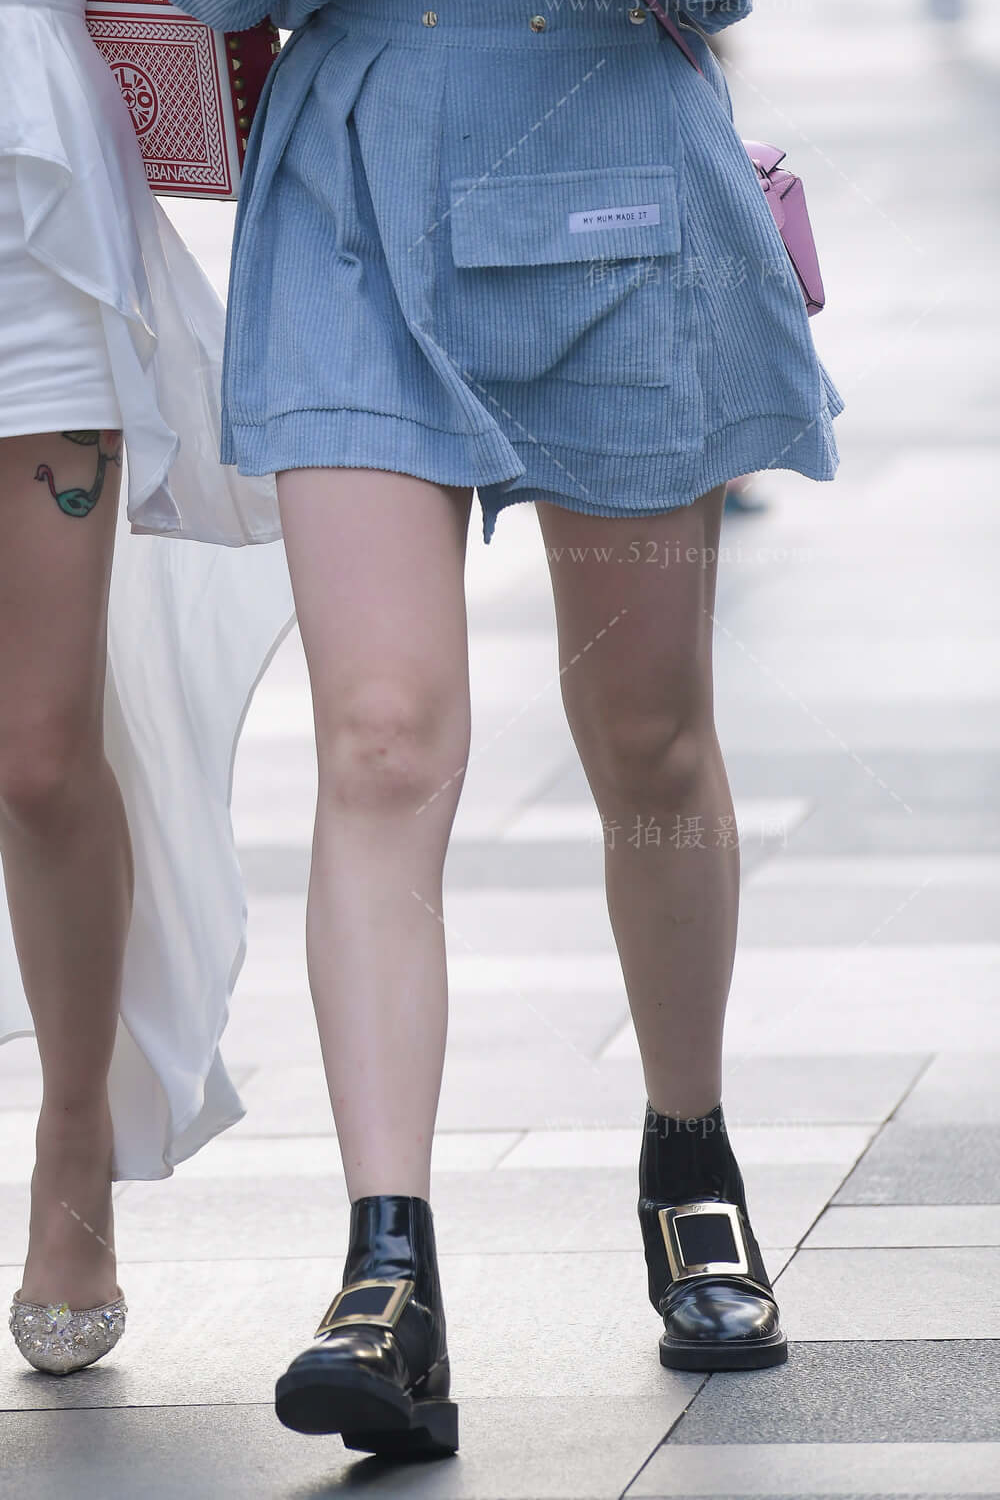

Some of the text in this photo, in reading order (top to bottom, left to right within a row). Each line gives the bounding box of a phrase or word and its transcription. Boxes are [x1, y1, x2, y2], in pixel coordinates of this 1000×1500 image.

[145, 163, 187, 182] BBANA
[597, 214, 613, 223] MUM
[616, 212, 635, 220] MADE
[638, 211, 648, 220] IT
